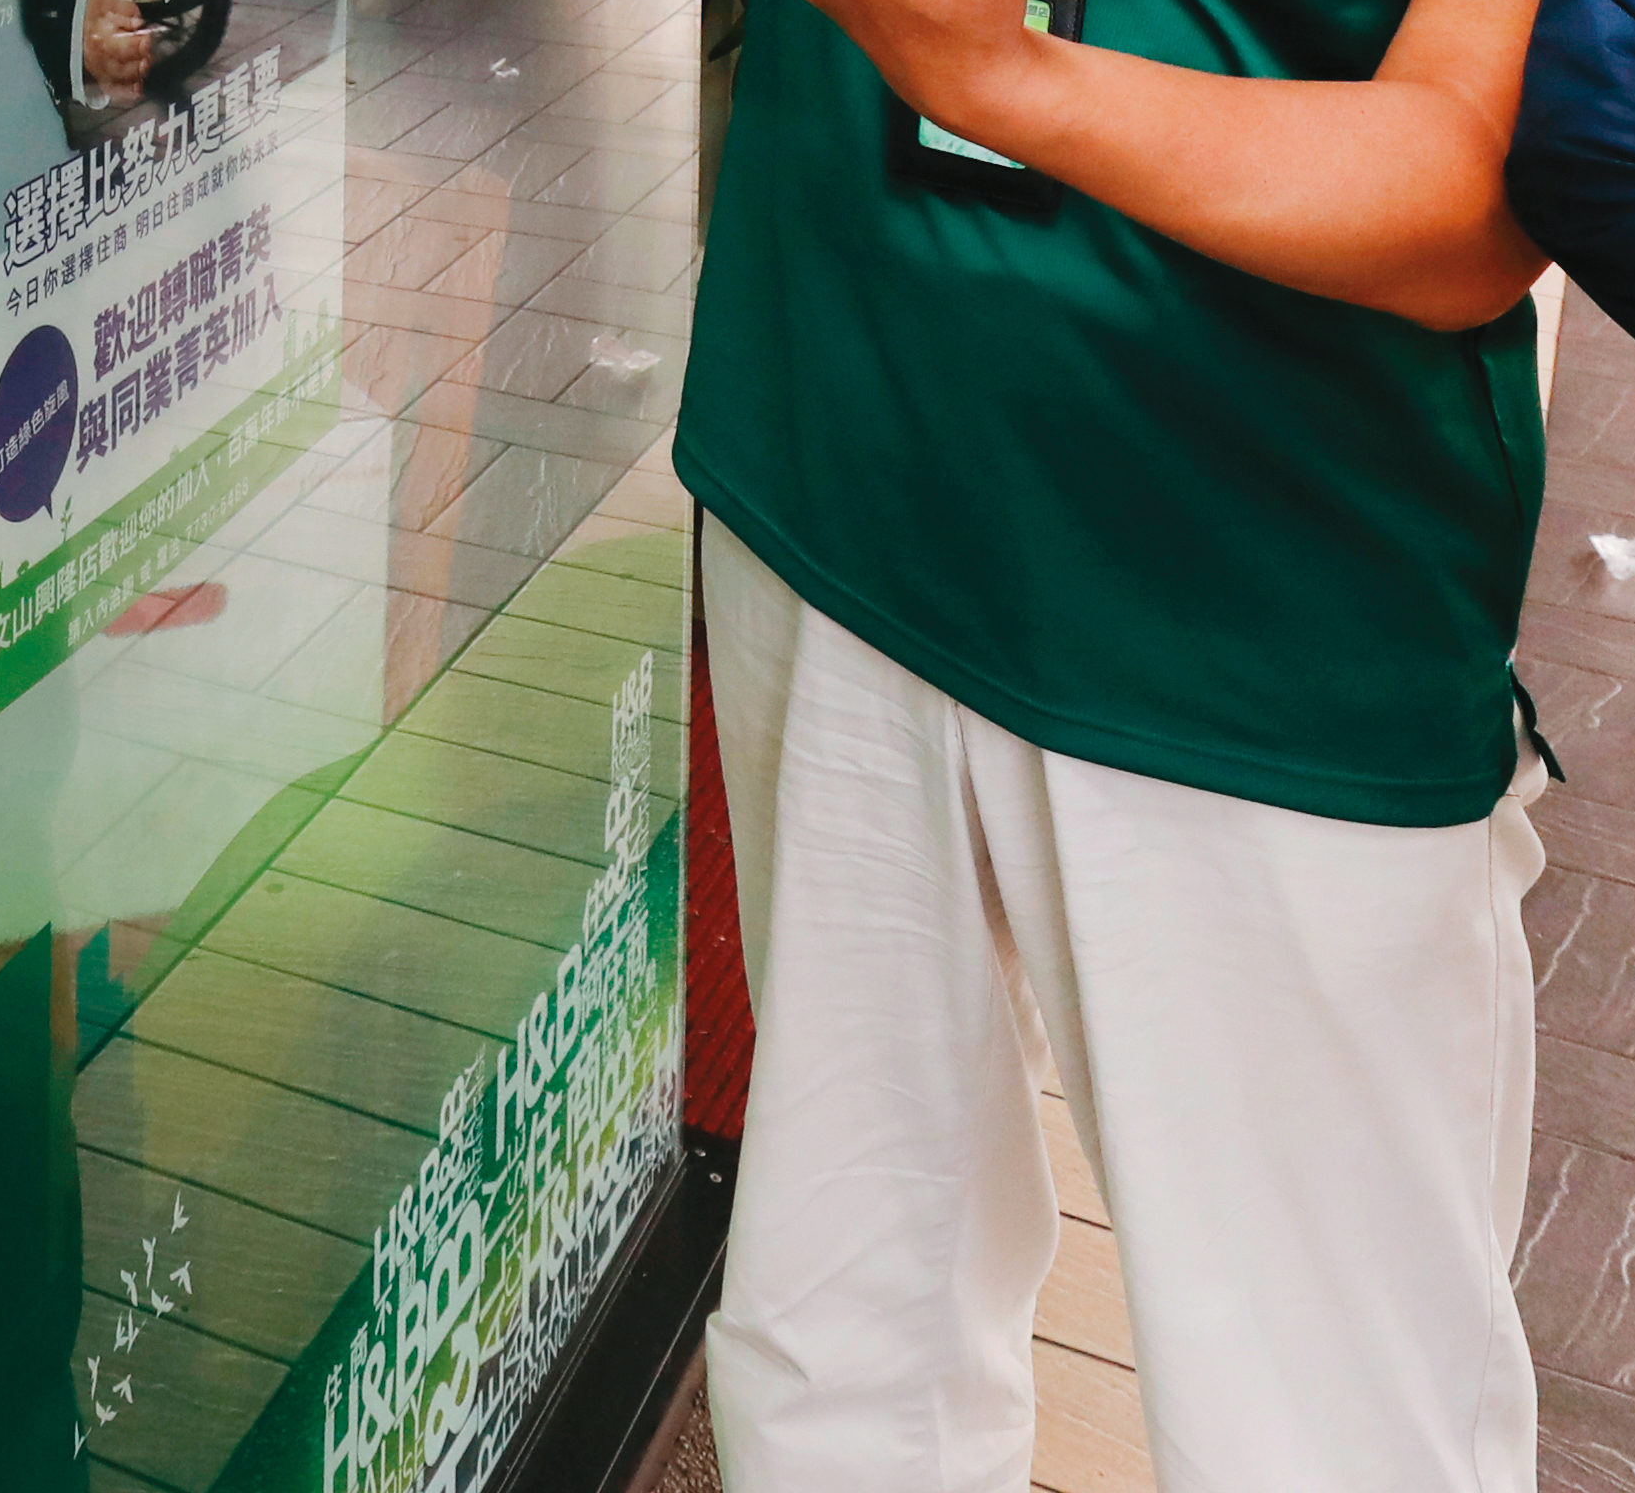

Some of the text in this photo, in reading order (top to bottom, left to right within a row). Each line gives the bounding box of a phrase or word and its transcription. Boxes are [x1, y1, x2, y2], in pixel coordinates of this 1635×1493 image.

[3, 44, 282, 277] 選擇比努力更重要
[75, 271, 285, 476] 與同業菁英加入
[93, 203, 273, 383] 歡迎轉職菁英
[496, 942, 582, 1162] H&B
[373, 1147, 440, 1309] H&B
